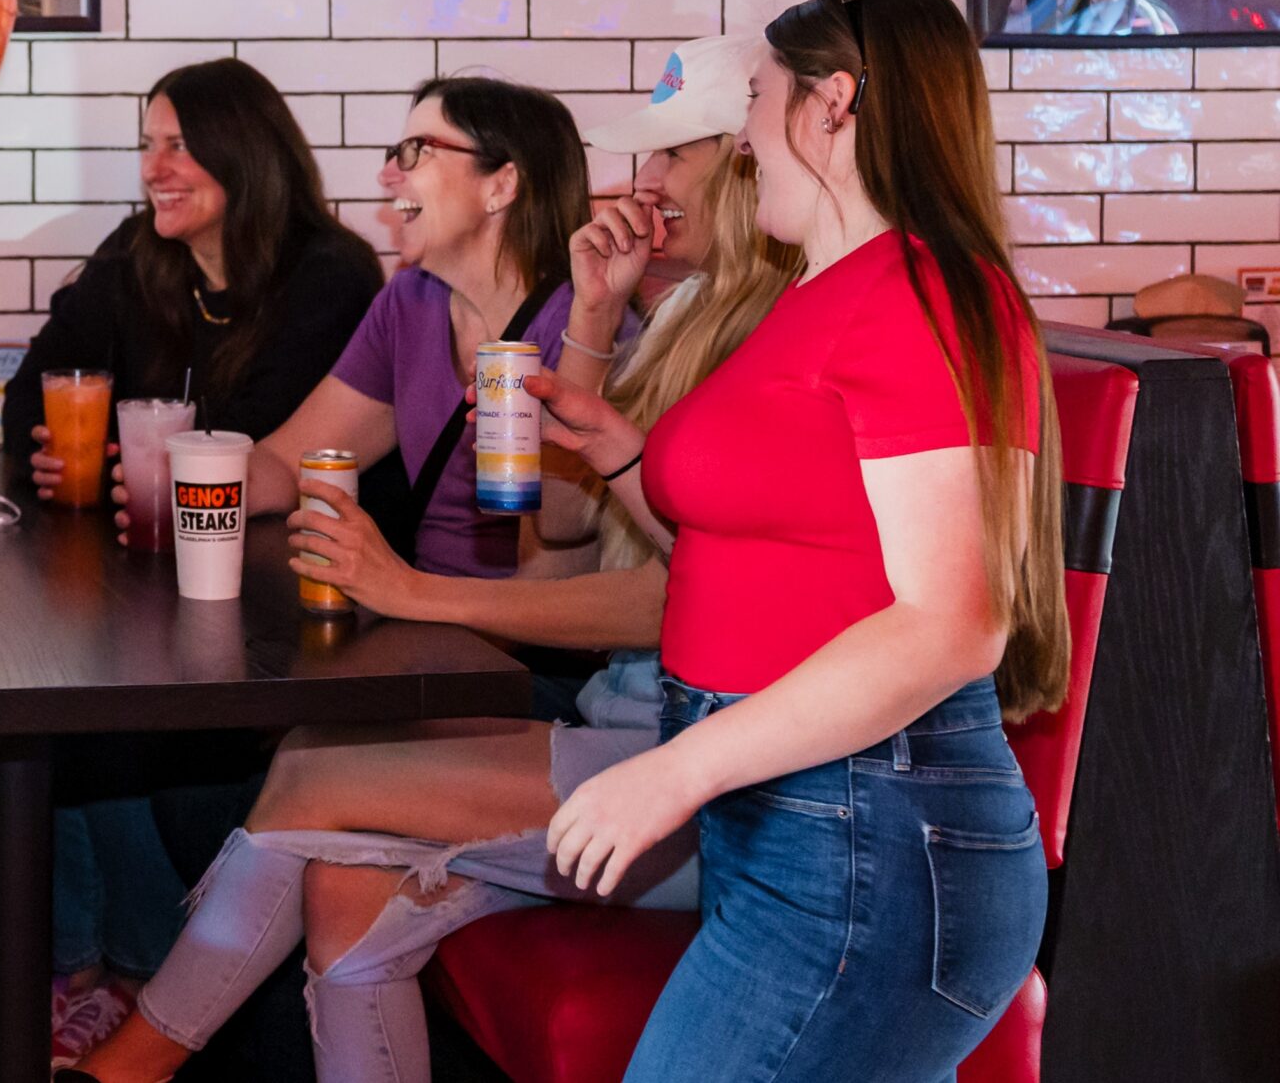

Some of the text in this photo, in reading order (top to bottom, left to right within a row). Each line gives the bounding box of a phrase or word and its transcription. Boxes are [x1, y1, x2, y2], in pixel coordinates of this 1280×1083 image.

[478, 372, 524, 390] Surfsid
[178, 486, 239, 507] GENO'S
[181, 511, 236, 530] STEAKS
